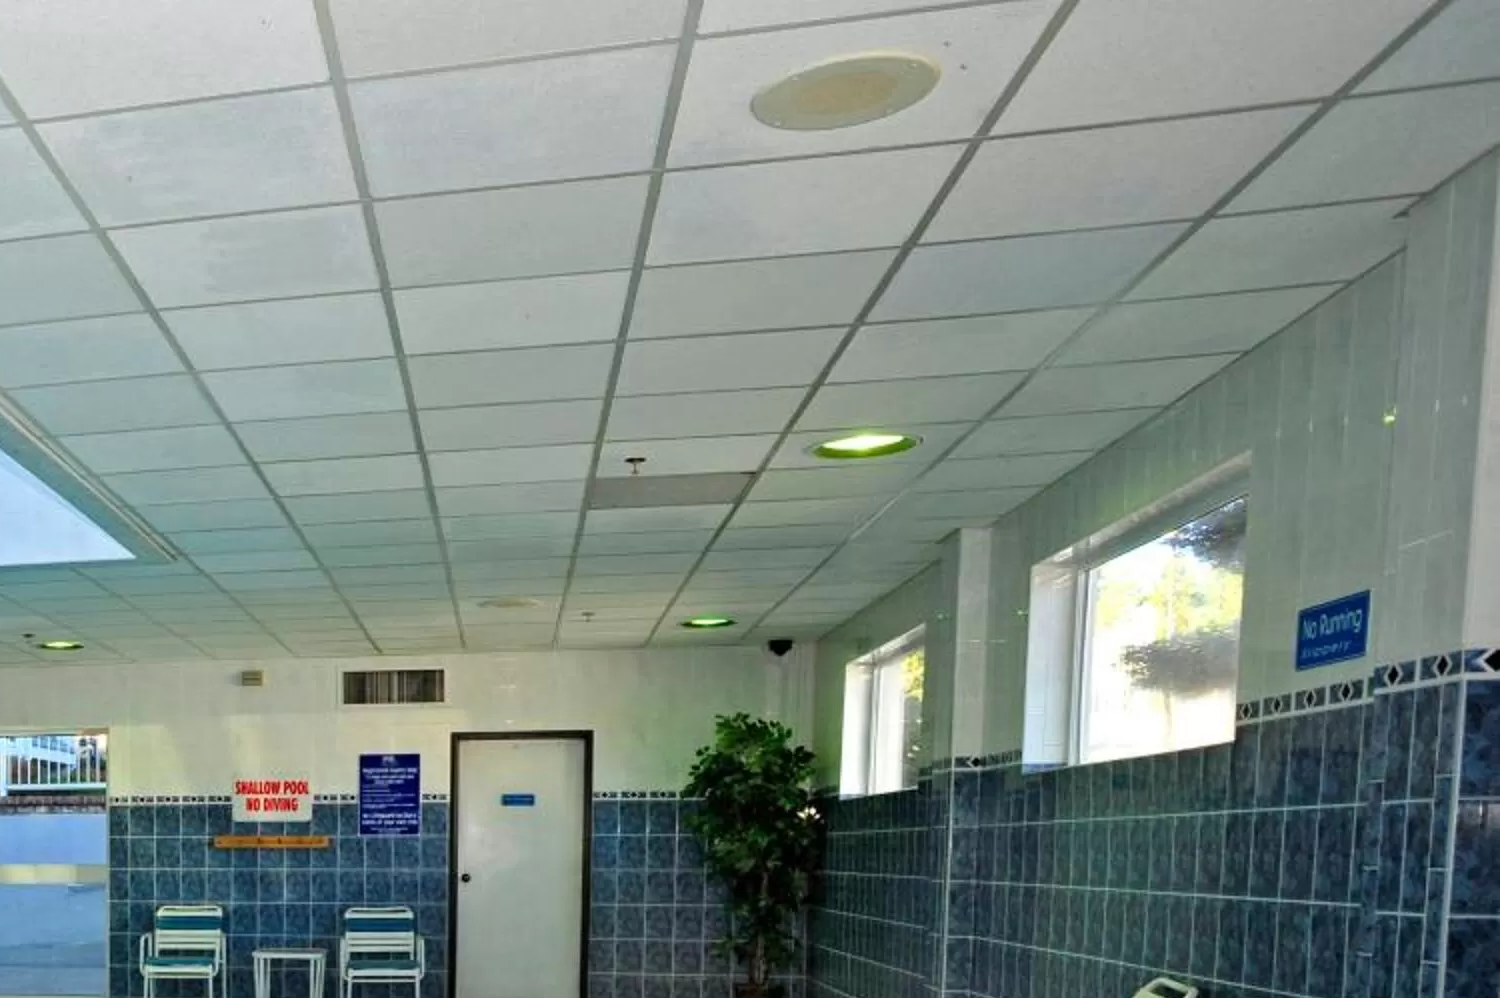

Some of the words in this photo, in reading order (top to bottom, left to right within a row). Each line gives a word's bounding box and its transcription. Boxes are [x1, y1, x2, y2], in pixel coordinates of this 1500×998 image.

[1302, 620, 1316, 640] No
[1320, 608, 1363, 636] Running
[235, 781, 281, 795] SHALLOW
[283, 781, 309, 795] POOL
[246, 798, 261, 811] NO
[263, 798, 299, 811] DIVING
